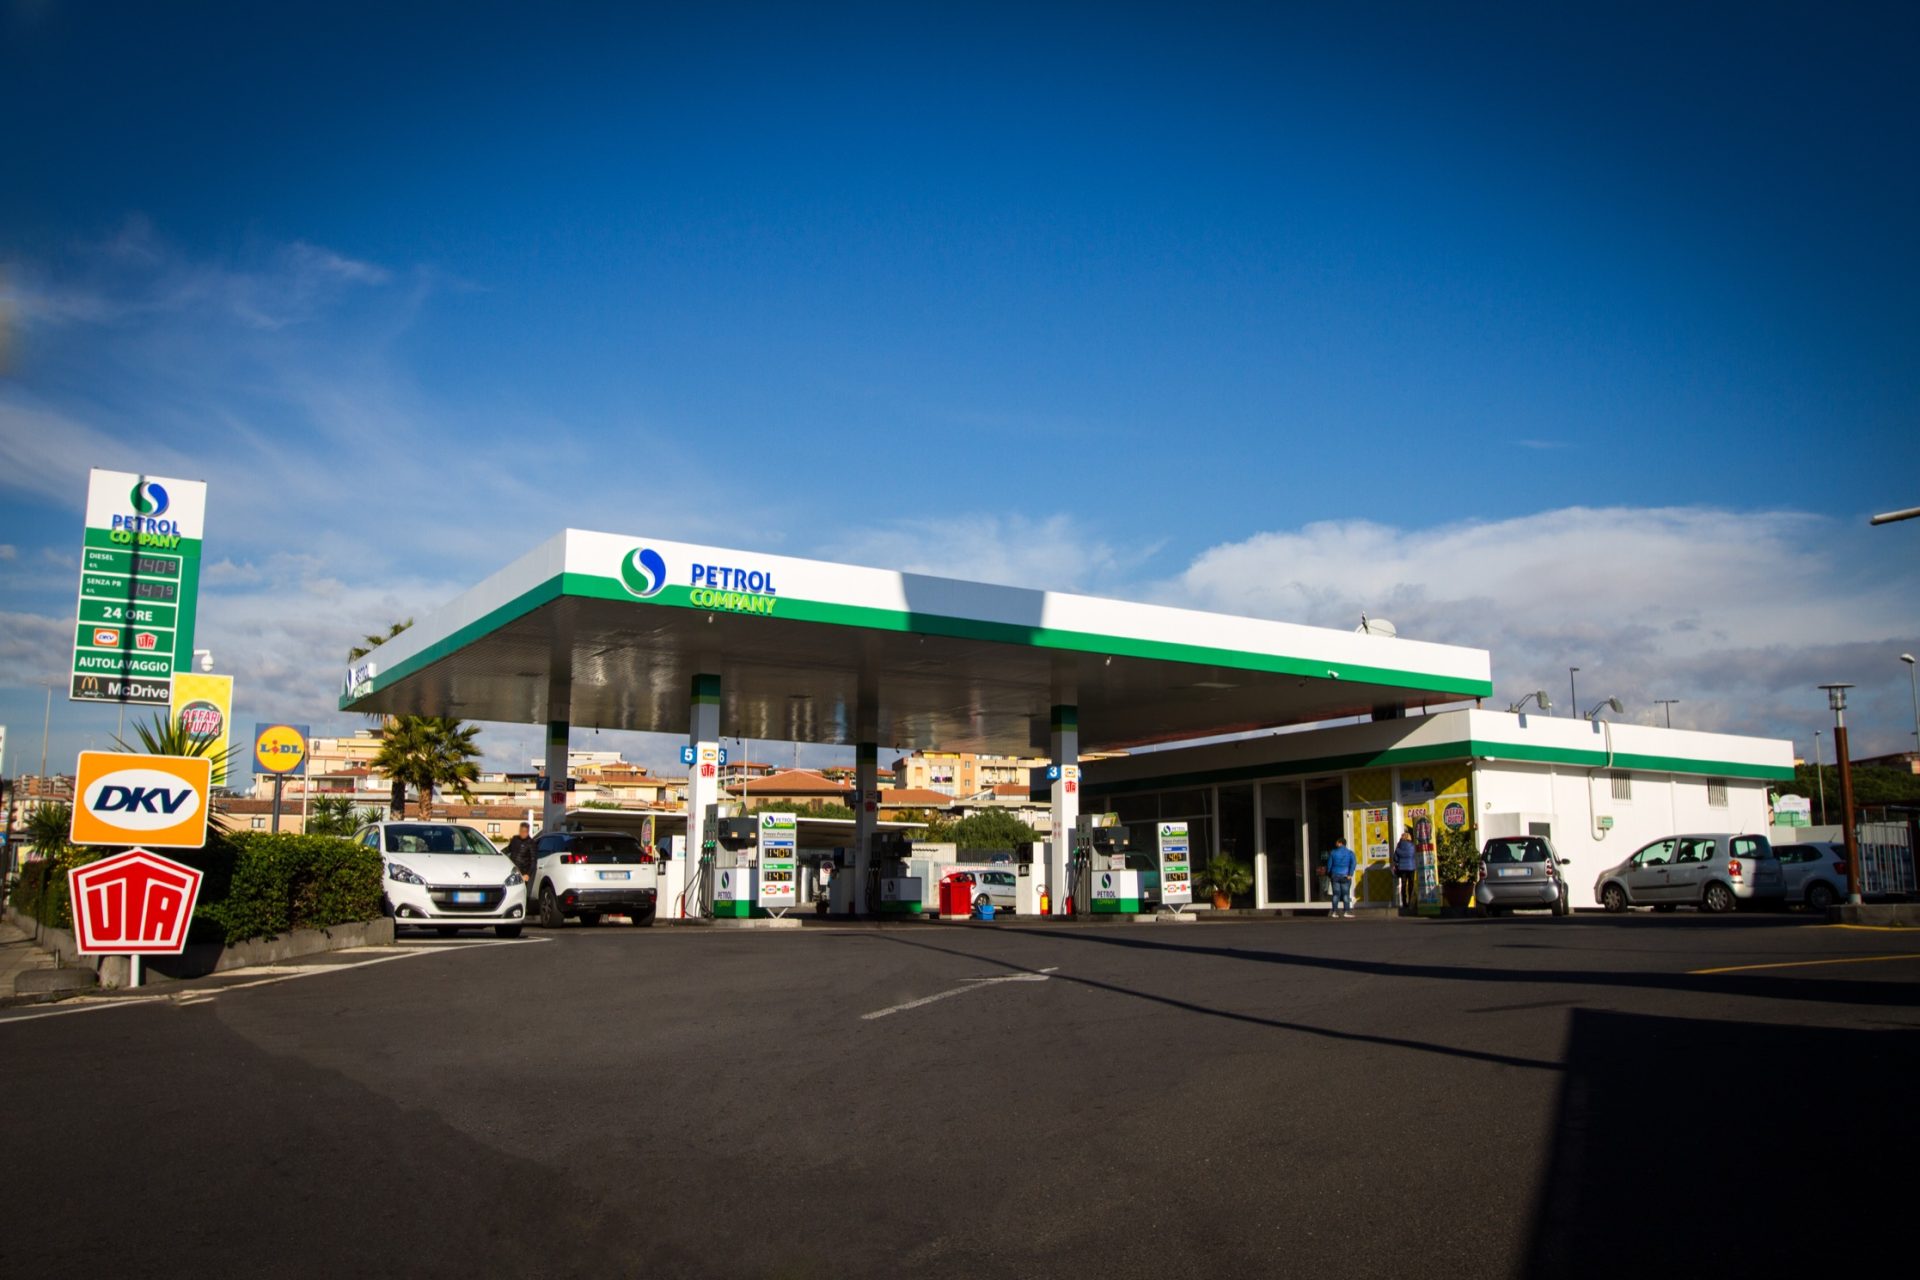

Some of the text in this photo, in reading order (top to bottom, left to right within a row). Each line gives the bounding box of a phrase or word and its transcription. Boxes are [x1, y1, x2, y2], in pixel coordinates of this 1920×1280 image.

[112, 514, 181, 535] PETROL
[89, 552, 114, 561] DIESEL
[86, 577, 110, 586] SENZA
[691, 563, 776, 594] PETROL
[690, 588, 777, 614] COMPANY
[102, 606, 153, 621] 24 ORE
[78, 656, 169, 673] AUTOLAVAGGIO
[107, 682, 169, 699] McDrive
[182, 708, 221, 723] AFFARI
[684, 748, 694, 761] 5
[719, 750, 725, 763] 6
[1050, 766, 1058, 778] 3
[93, 784, 193, 814] DKV
[84, 860, 188, 941] UTA
